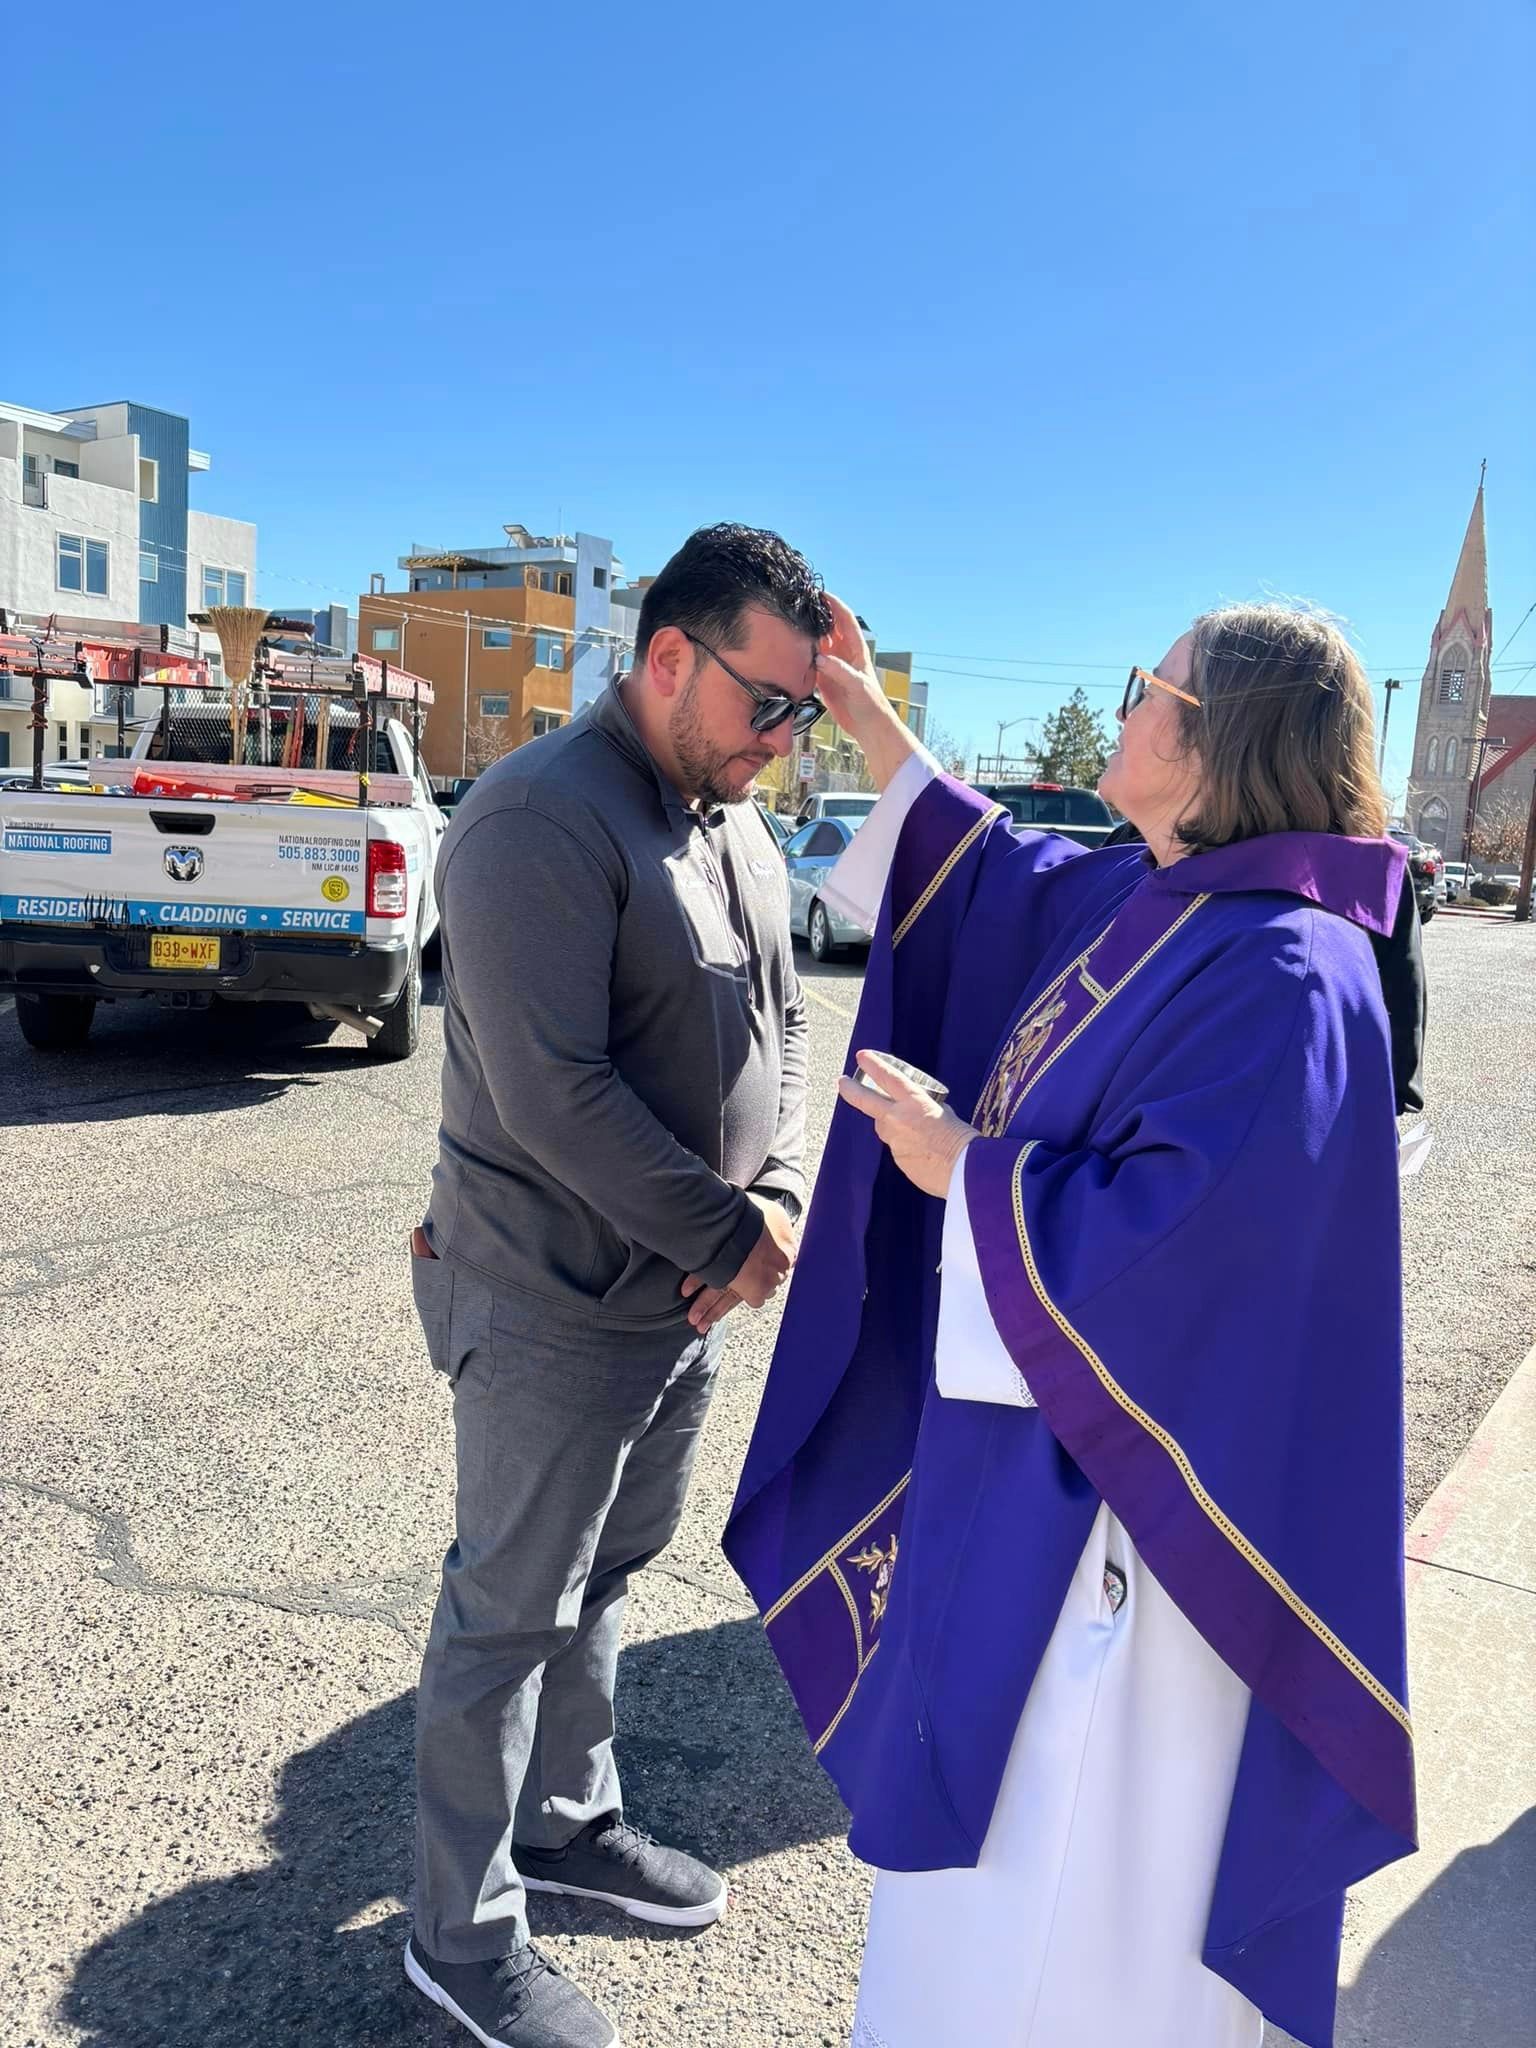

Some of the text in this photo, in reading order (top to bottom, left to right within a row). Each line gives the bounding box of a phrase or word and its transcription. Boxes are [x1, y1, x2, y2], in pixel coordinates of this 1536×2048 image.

[8, 834, 108, 851] NATIONAL ROOFING
[278, 835, 361, 847] NATIONALROOFING.COM
[278, 846, 360, 862] 505.883.3000
[311, 863, 323, 871] NM
[324, 864, 340, 872] LIC#
[160, 905, 247, 924] CLADDING
[281, 910, 351, 929] SERVICE
